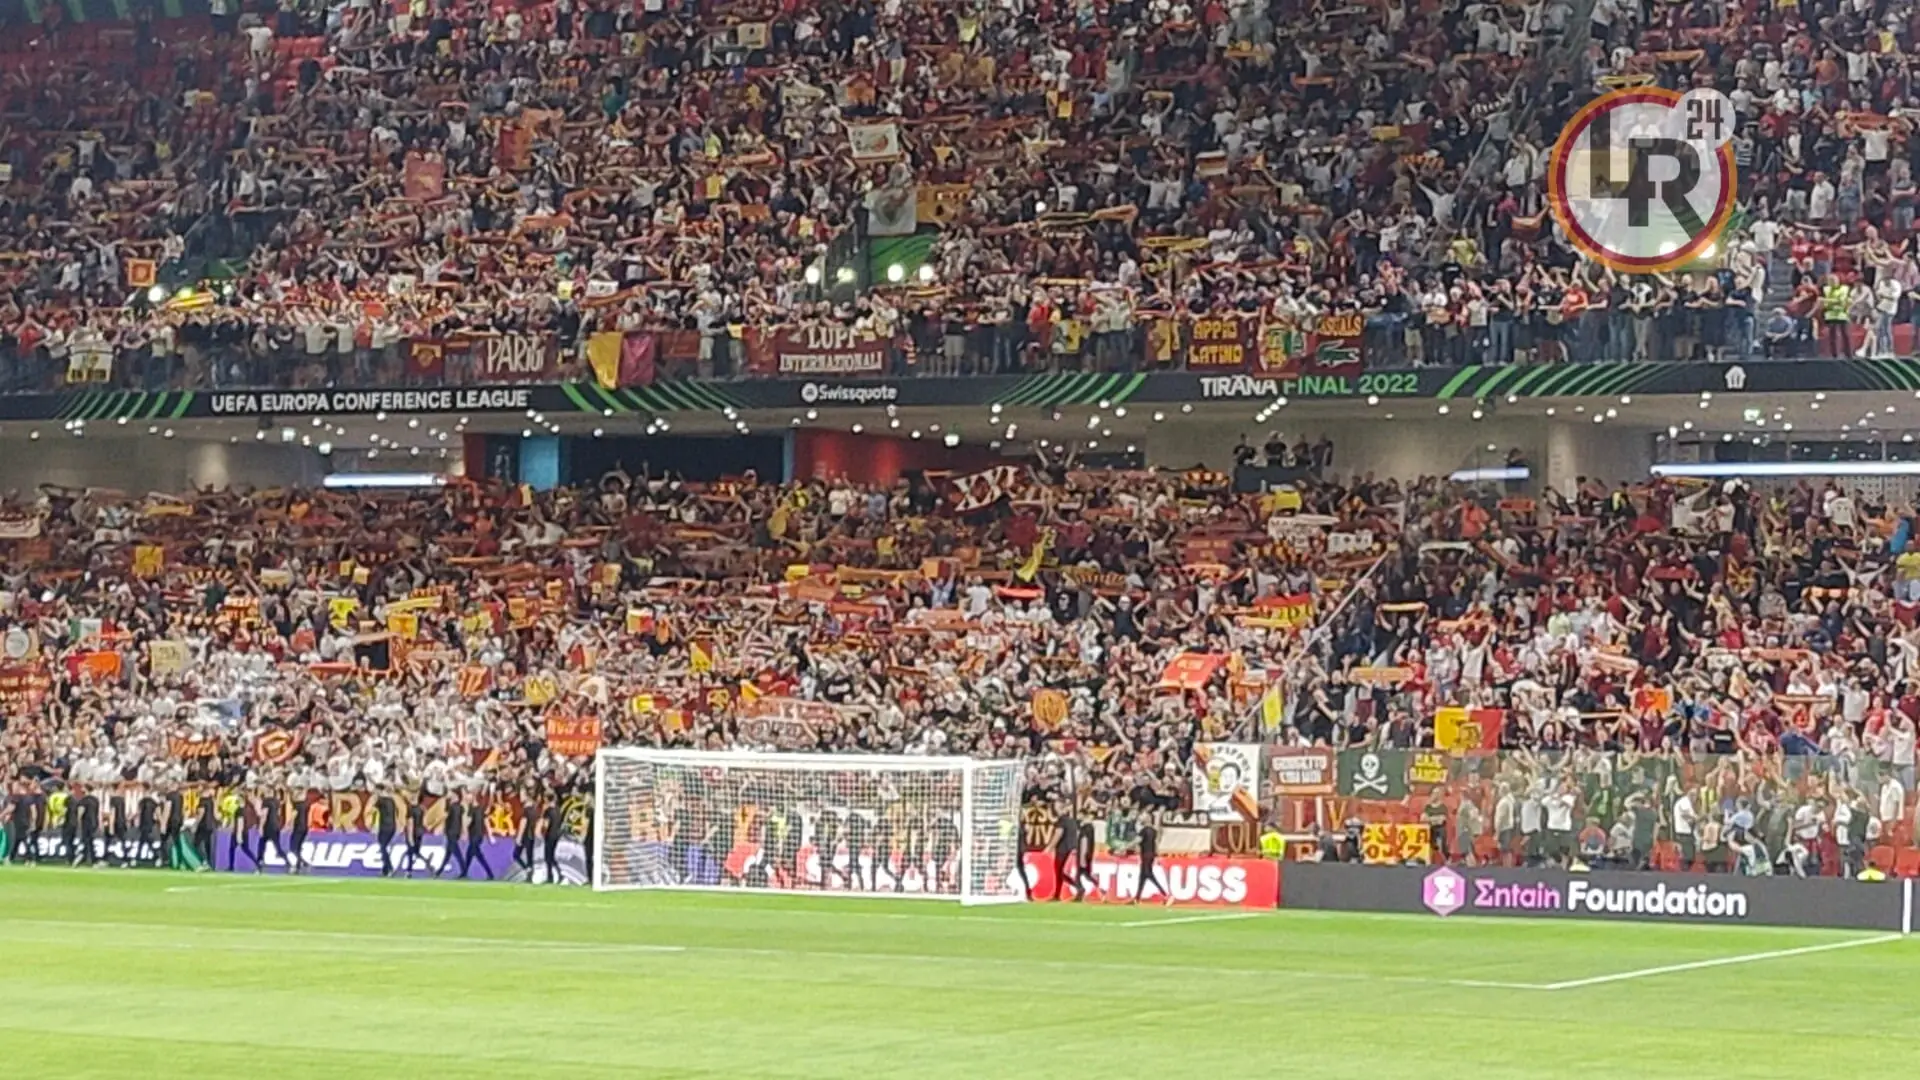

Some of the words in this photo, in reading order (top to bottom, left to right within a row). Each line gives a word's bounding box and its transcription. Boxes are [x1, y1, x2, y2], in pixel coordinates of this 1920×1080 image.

[778, 351, 883, 372] INTERNAZIONALI
[1188, 344, 1244, 364] LATINO
[819, 383, 898, 404] Swissquote
[1283, 377, 1353, 395] FINAL
[1359, 374, 1419, 394] 2022
[211, 394, 258, 412] UEFA
[260, 393, 329, 411] EUROPA
[332, 391, 452, 411] CONFERENCE
[455, 389, 528, 409] LEAGUE
[1567, 880, 1747, 917] Foundation
